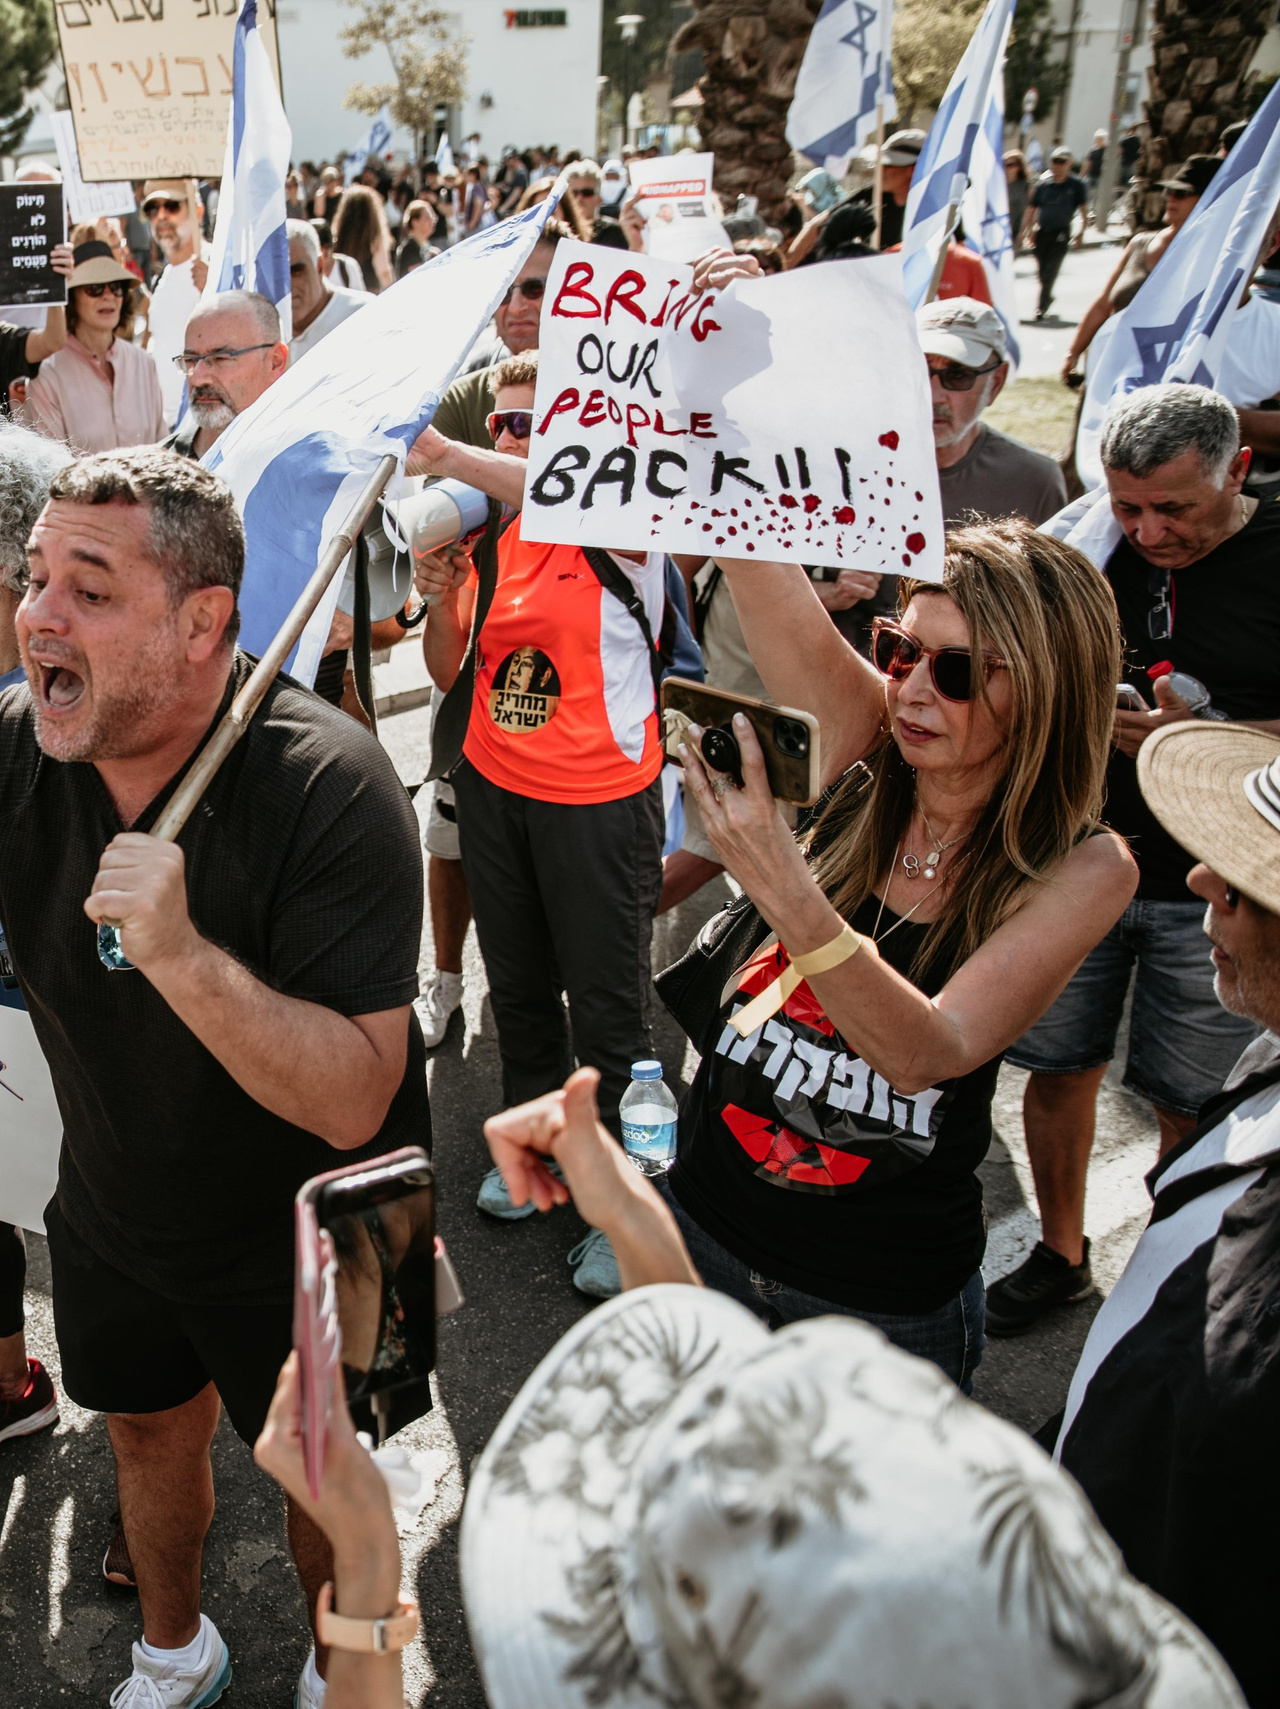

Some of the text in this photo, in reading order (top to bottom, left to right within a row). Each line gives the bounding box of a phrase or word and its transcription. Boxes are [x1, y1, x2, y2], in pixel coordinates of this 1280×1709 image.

[552, 261, 721, 342] BRING
[577, 333, 661, 398] OUR
[535, 387, 718, 449] PEOPLE
[493, 705, 546, 727] ישראל
[496, 691, 547, 712] מחריב
